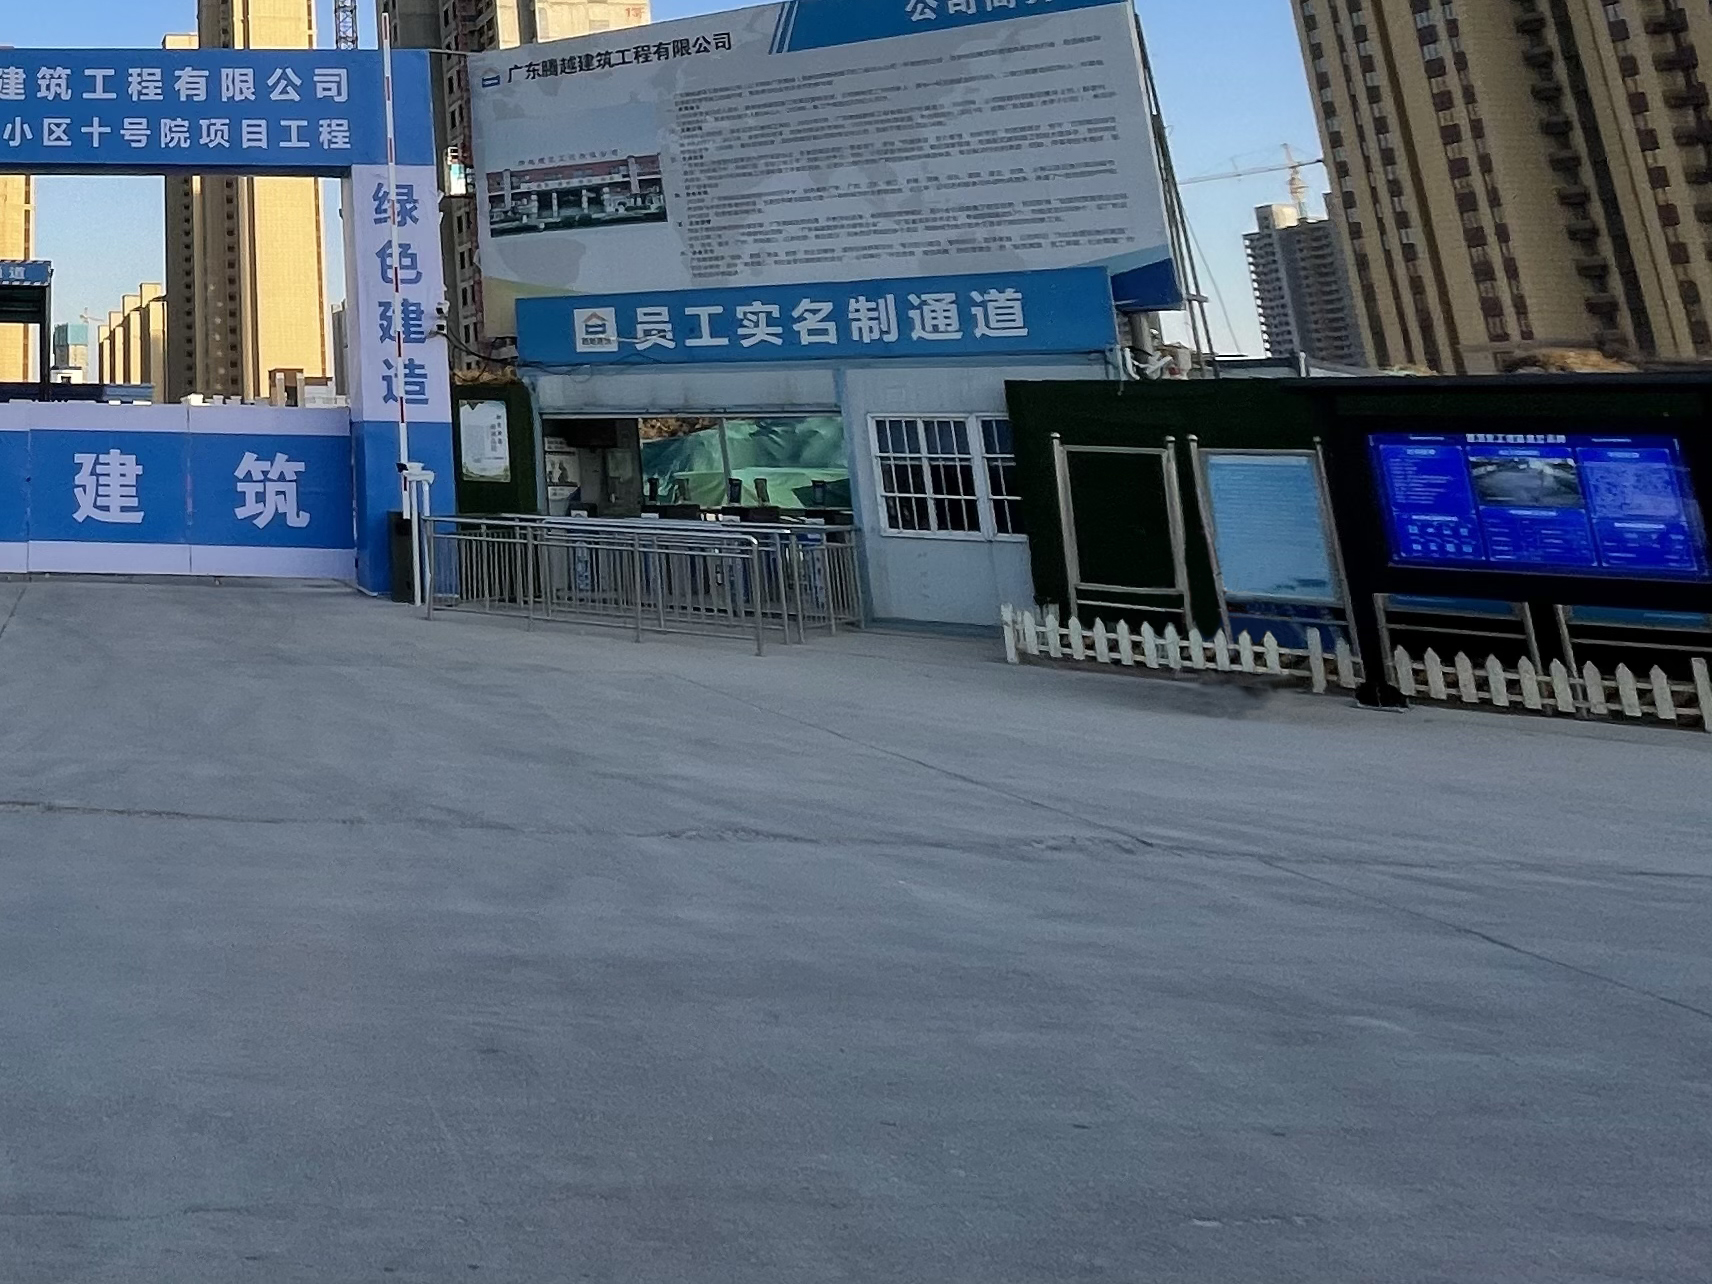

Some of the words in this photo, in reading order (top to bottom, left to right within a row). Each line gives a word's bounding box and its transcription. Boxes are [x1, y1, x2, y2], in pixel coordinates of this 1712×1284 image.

[507, 31, 732, 83] 广东腾越建筑工程有限公司
[372, 182, 430, 406] 绿色建造
[634, 290, 1030, 352] 员工实名制通道
